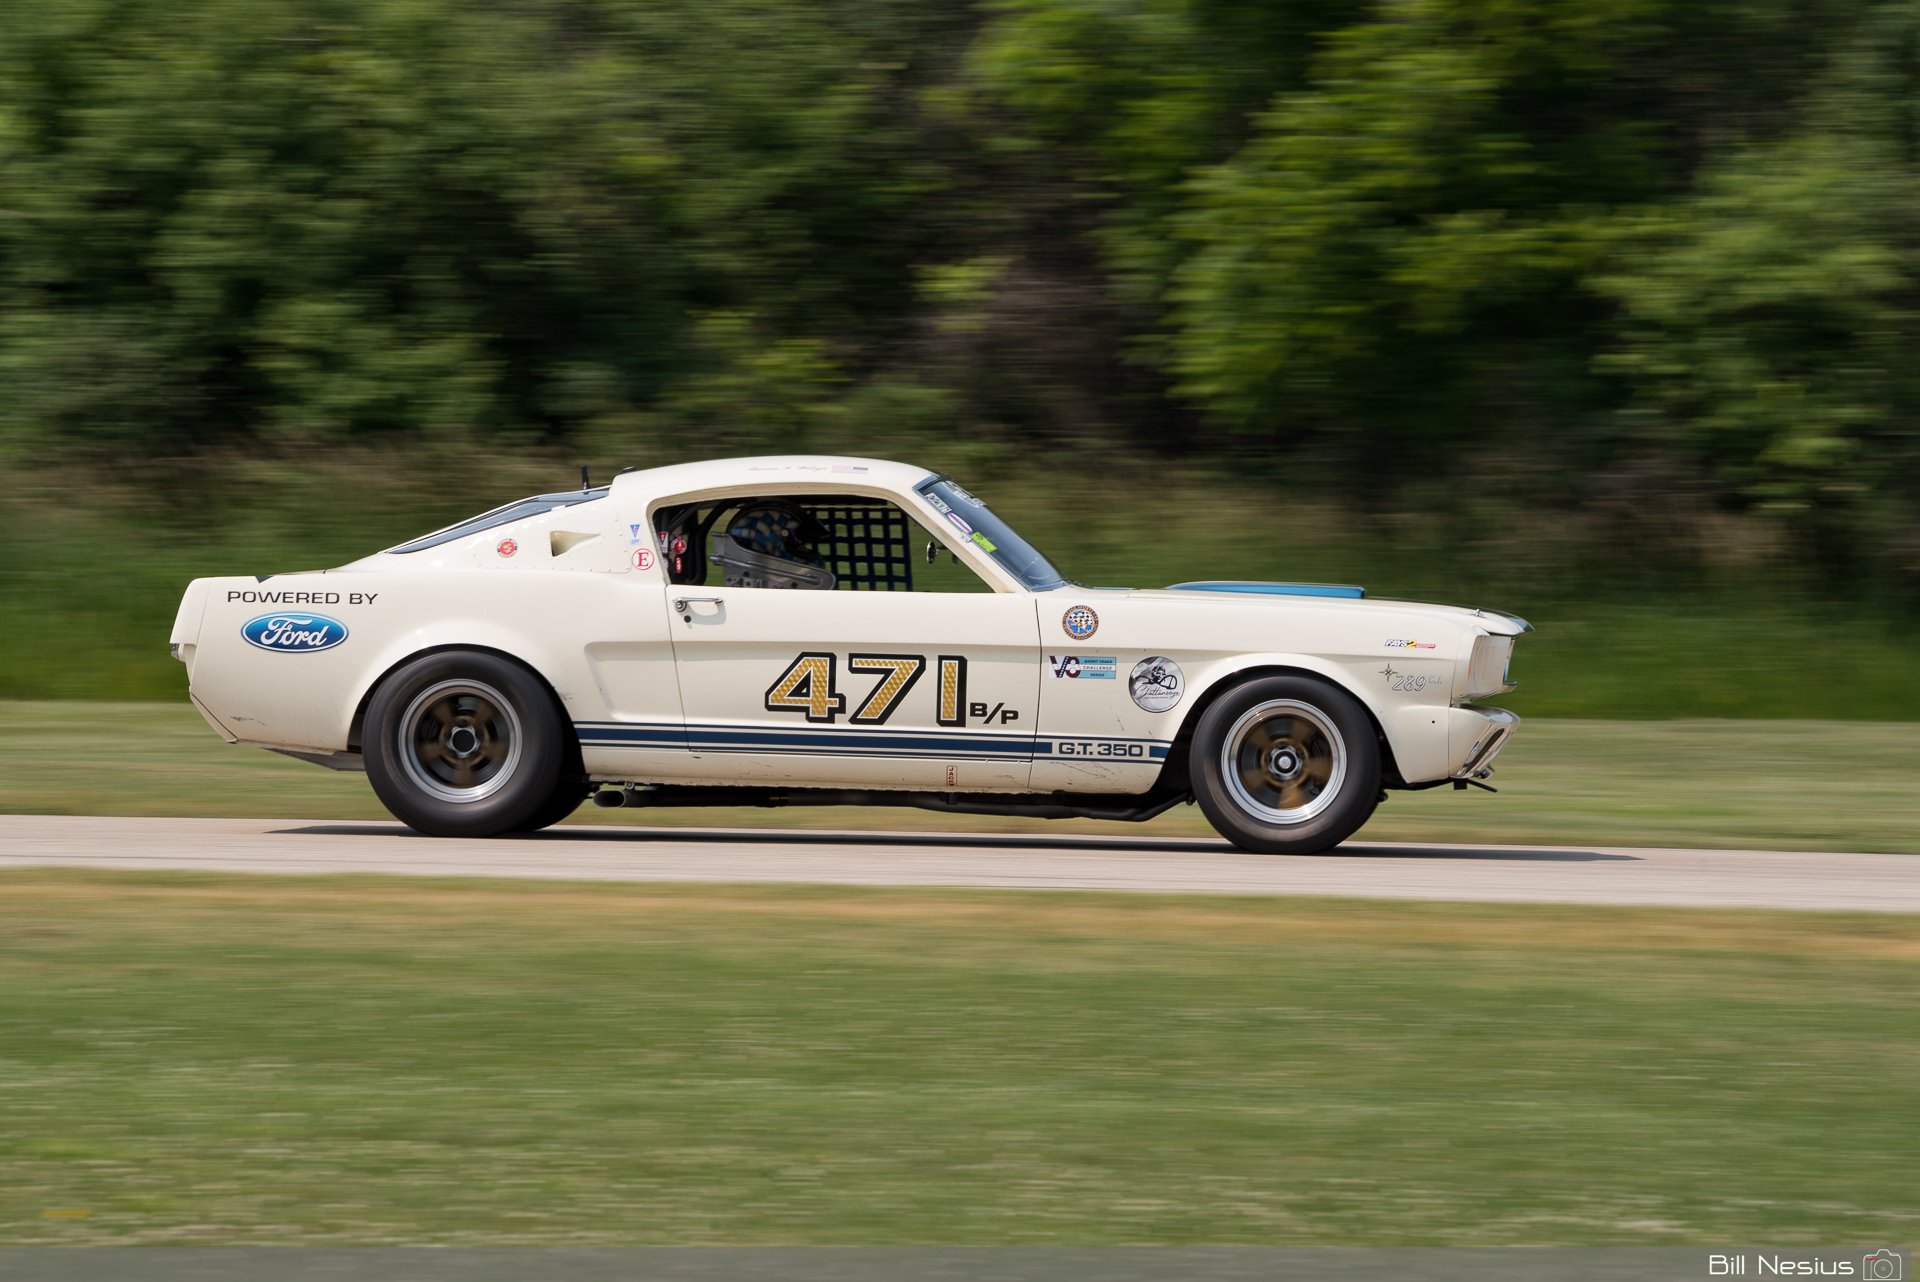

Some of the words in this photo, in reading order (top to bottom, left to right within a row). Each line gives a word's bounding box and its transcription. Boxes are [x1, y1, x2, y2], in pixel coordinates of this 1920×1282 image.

[637, 552, 649, 567] E
[227, 591, 340, 604] POWERED
[349, 593, 379, 605] BY
[260, 617, 330, 646] Ford
[1049, 656, 1081, 678] V8
[765, 652, 967, 727] 471
[1392, 674, 1426, 691] 289
[1134, 685, 1180, 700] Chattanooga
[970, 702, 1019, 724] B/P
[1059, 742, 1093, 755] G.T.
[1097, 743, 1143, 757] 350
